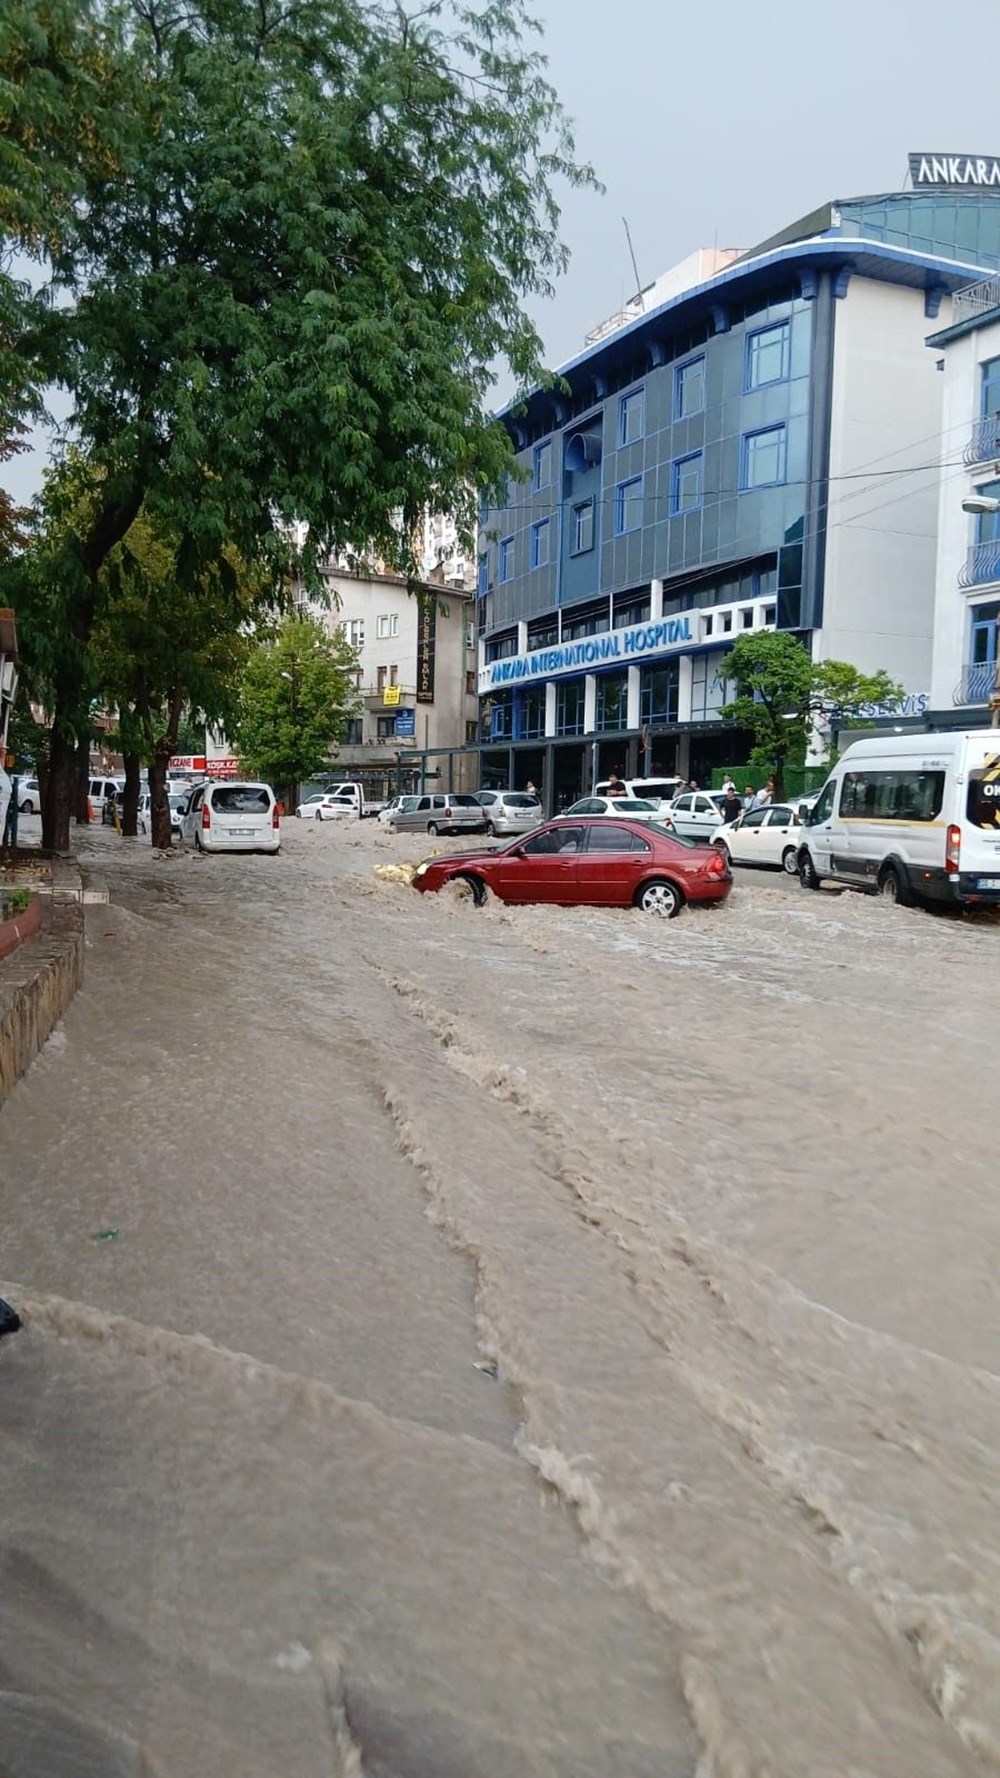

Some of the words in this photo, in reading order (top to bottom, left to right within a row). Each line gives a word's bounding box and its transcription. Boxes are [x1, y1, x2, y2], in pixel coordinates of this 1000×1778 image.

[918, 156, 1000, 184] ANKARA
[491, 652, 530, 683] ANKARA
[531, 635, 620, 674] INTERNATIONAL
[624, 617, 693, 653] HOSPITAL
